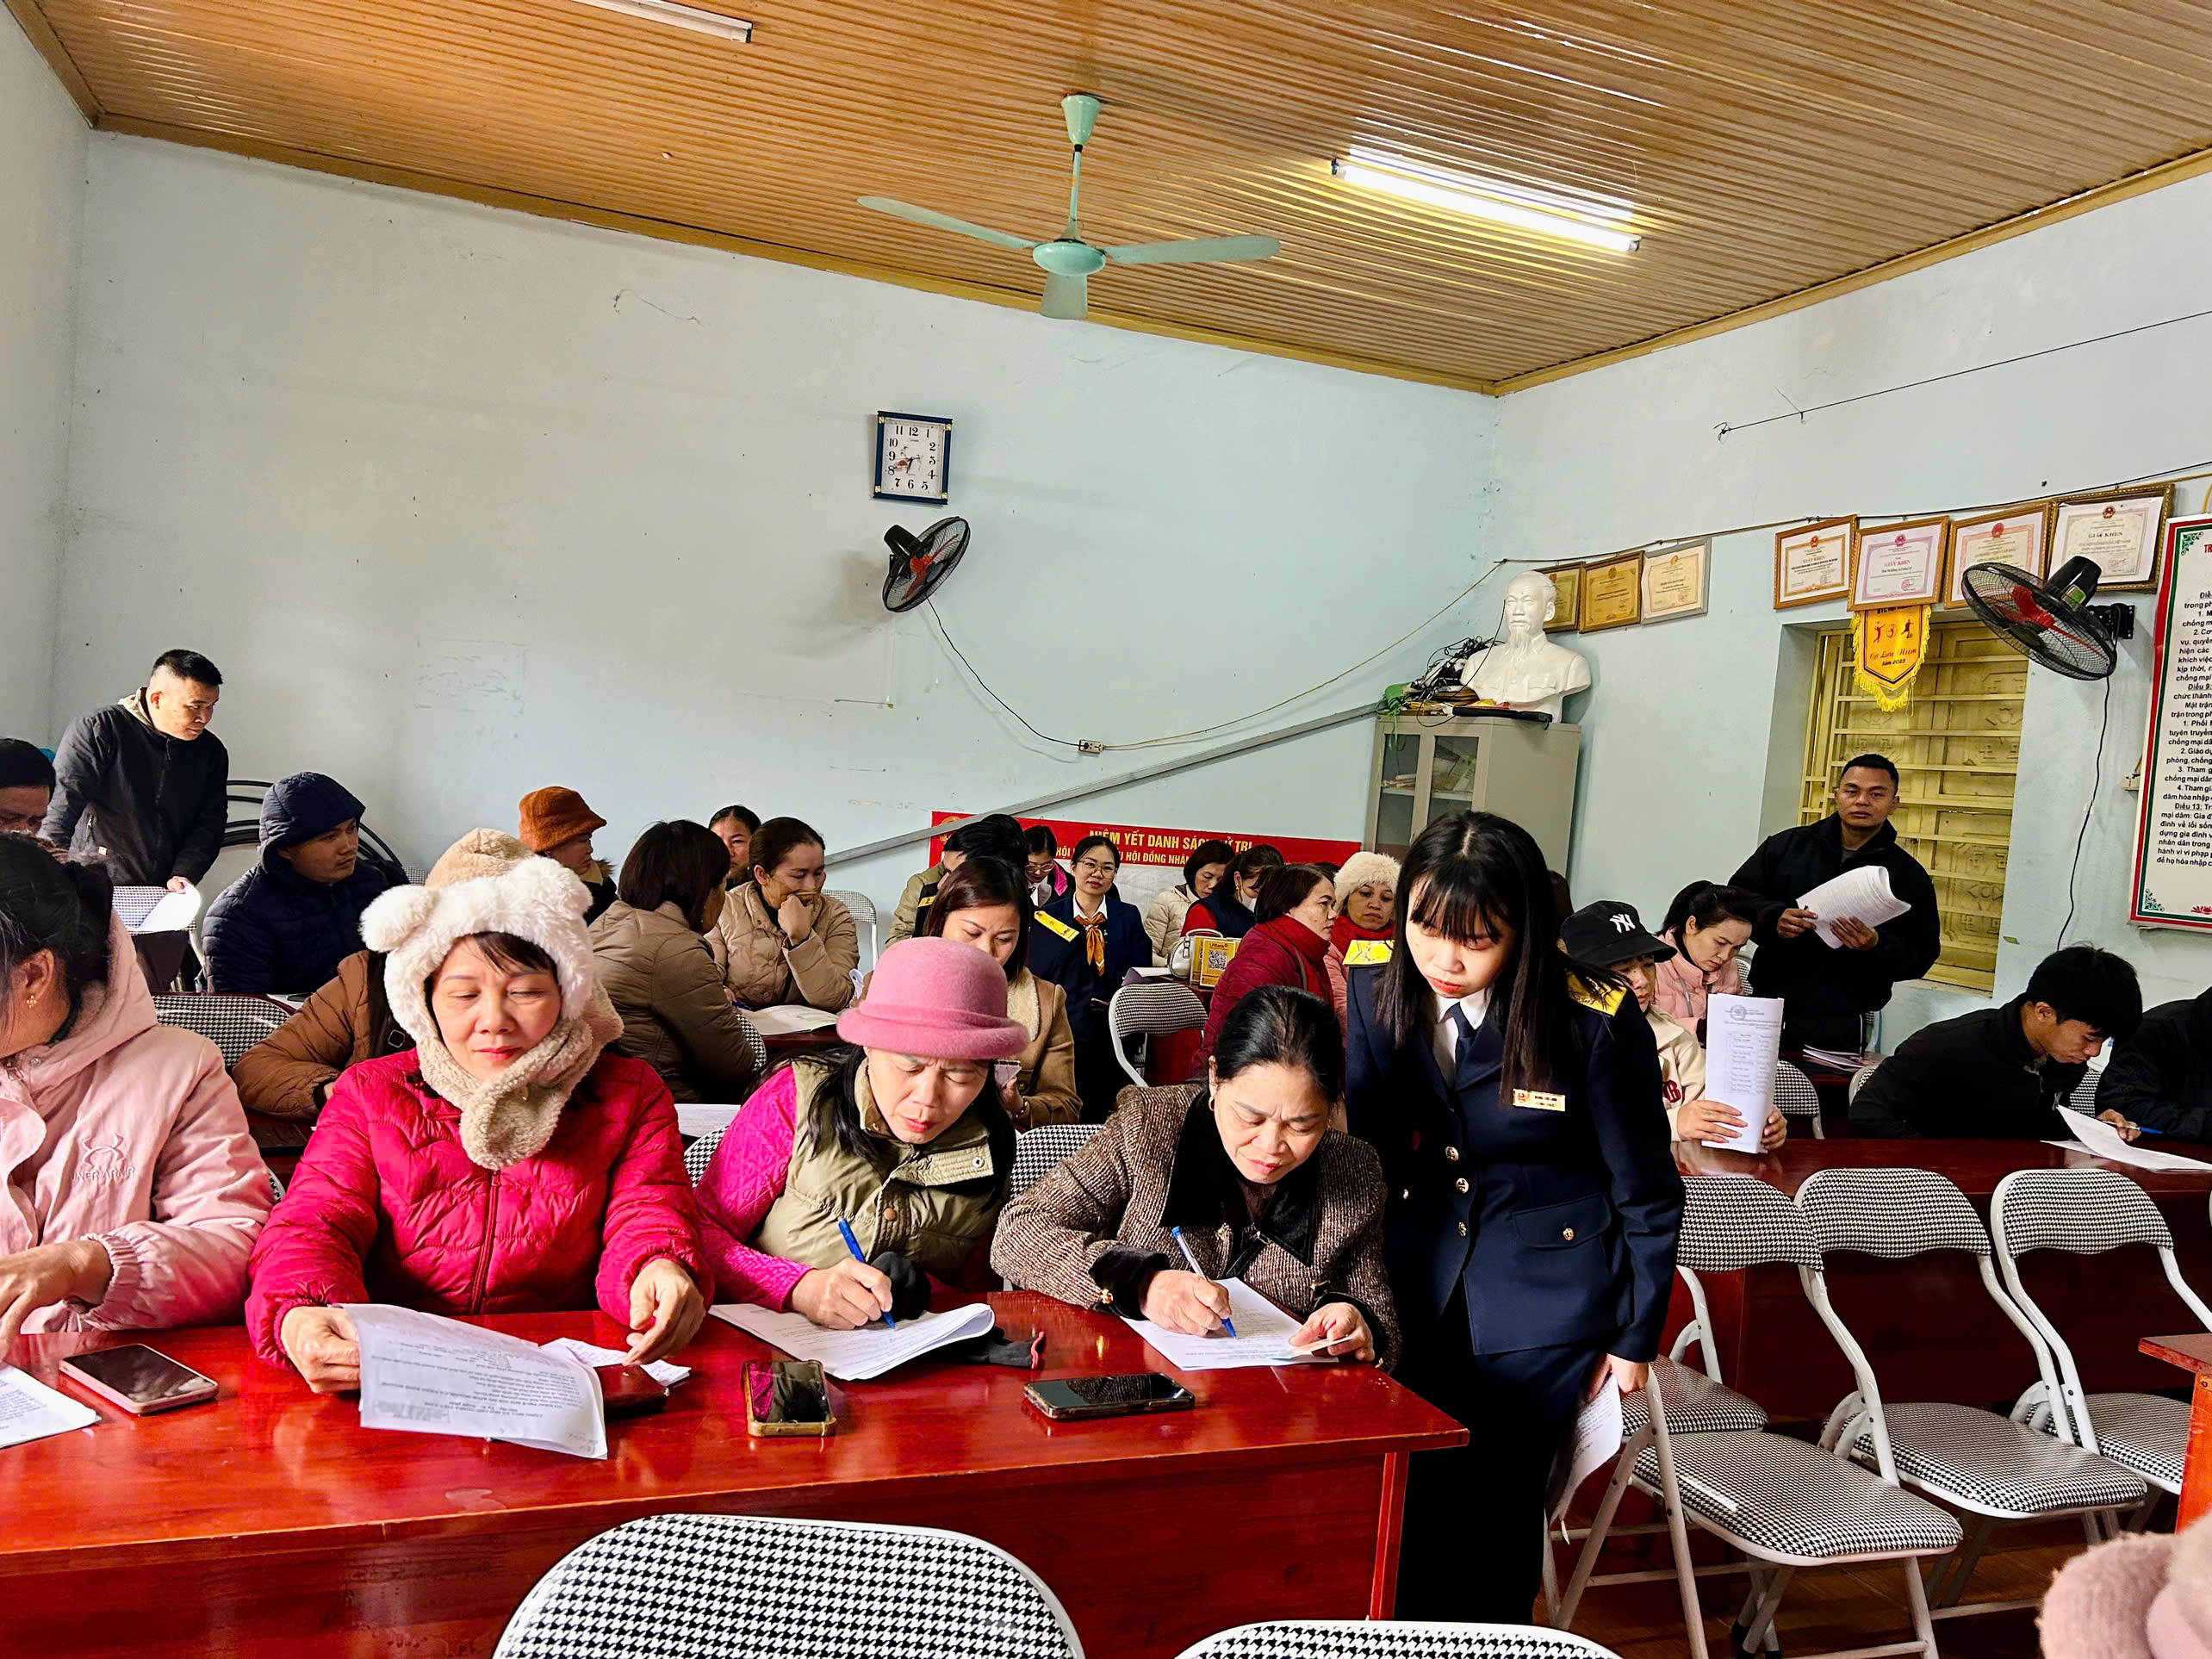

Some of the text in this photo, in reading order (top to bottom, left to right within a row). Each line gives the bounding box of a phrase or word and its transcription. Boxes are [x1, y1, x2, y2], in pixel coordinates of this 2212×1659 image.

[896, 426, 903, 435] 11
[909, 427, 919, 436] 12
[889, 438, 898, 447] 10
[929, 442, 936, 451] 2
[889, 451, 895, 461] 9
[929, 456, 936, 465] 3
[888, 466, 895, 475] 8
[927, 469, 936, 479] 4
[895, 477, 901, 488] 7
[907, 479, 914, 489] 6
[921, 481, 928, 491] 5
[1124, 830, 1144, 846] YẾT
[1148, 835, 1179, 848] DANH
[2192, 841, 2211, 849] trong
[1126, 851, 1140, 863] HỘI
[1143, 850, 1166, 864] ĐỒNG
